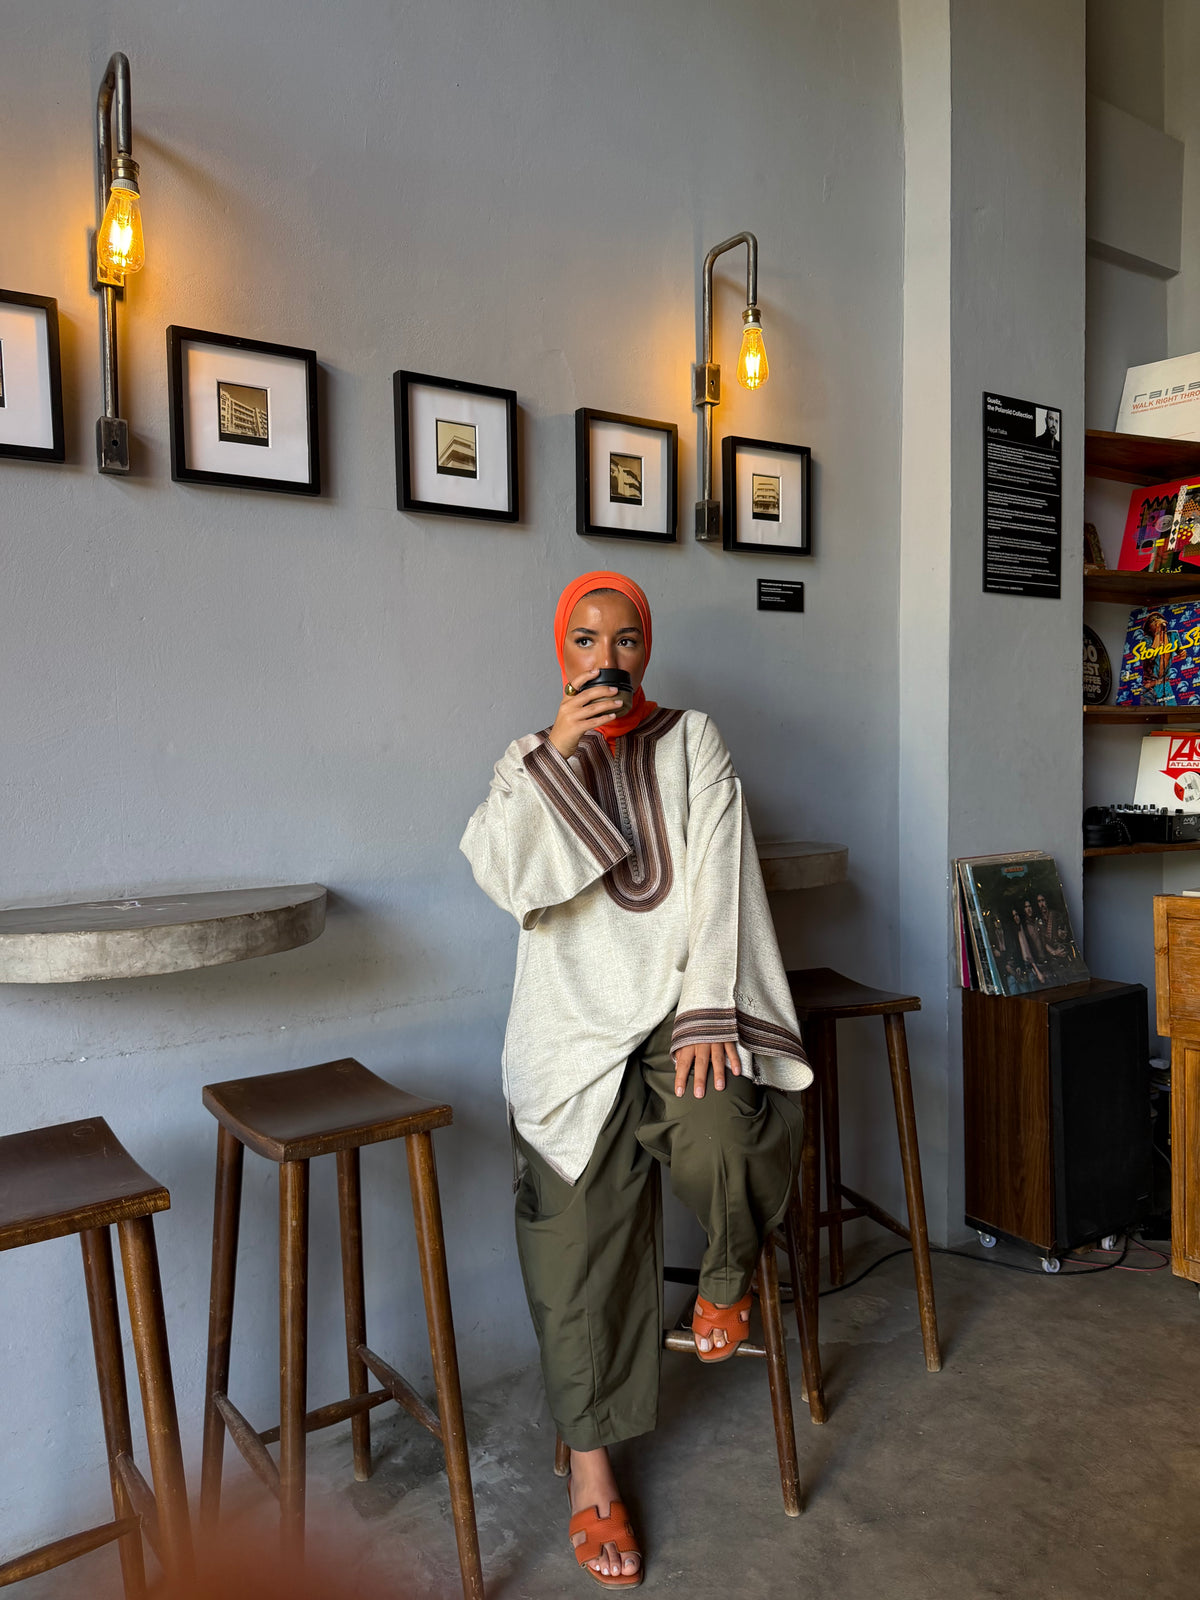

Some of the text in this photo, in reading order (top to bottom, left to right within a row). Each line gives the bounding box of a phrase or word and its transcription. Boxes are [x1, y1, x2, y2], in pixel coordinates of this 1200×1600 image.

[1132, 400, 1155, 410] WALK
[1155, 395, 1178, 405] RIGHT
[1013, 410, 1034, 420] Collection
[1127, 639, 1178, 664] Stones
